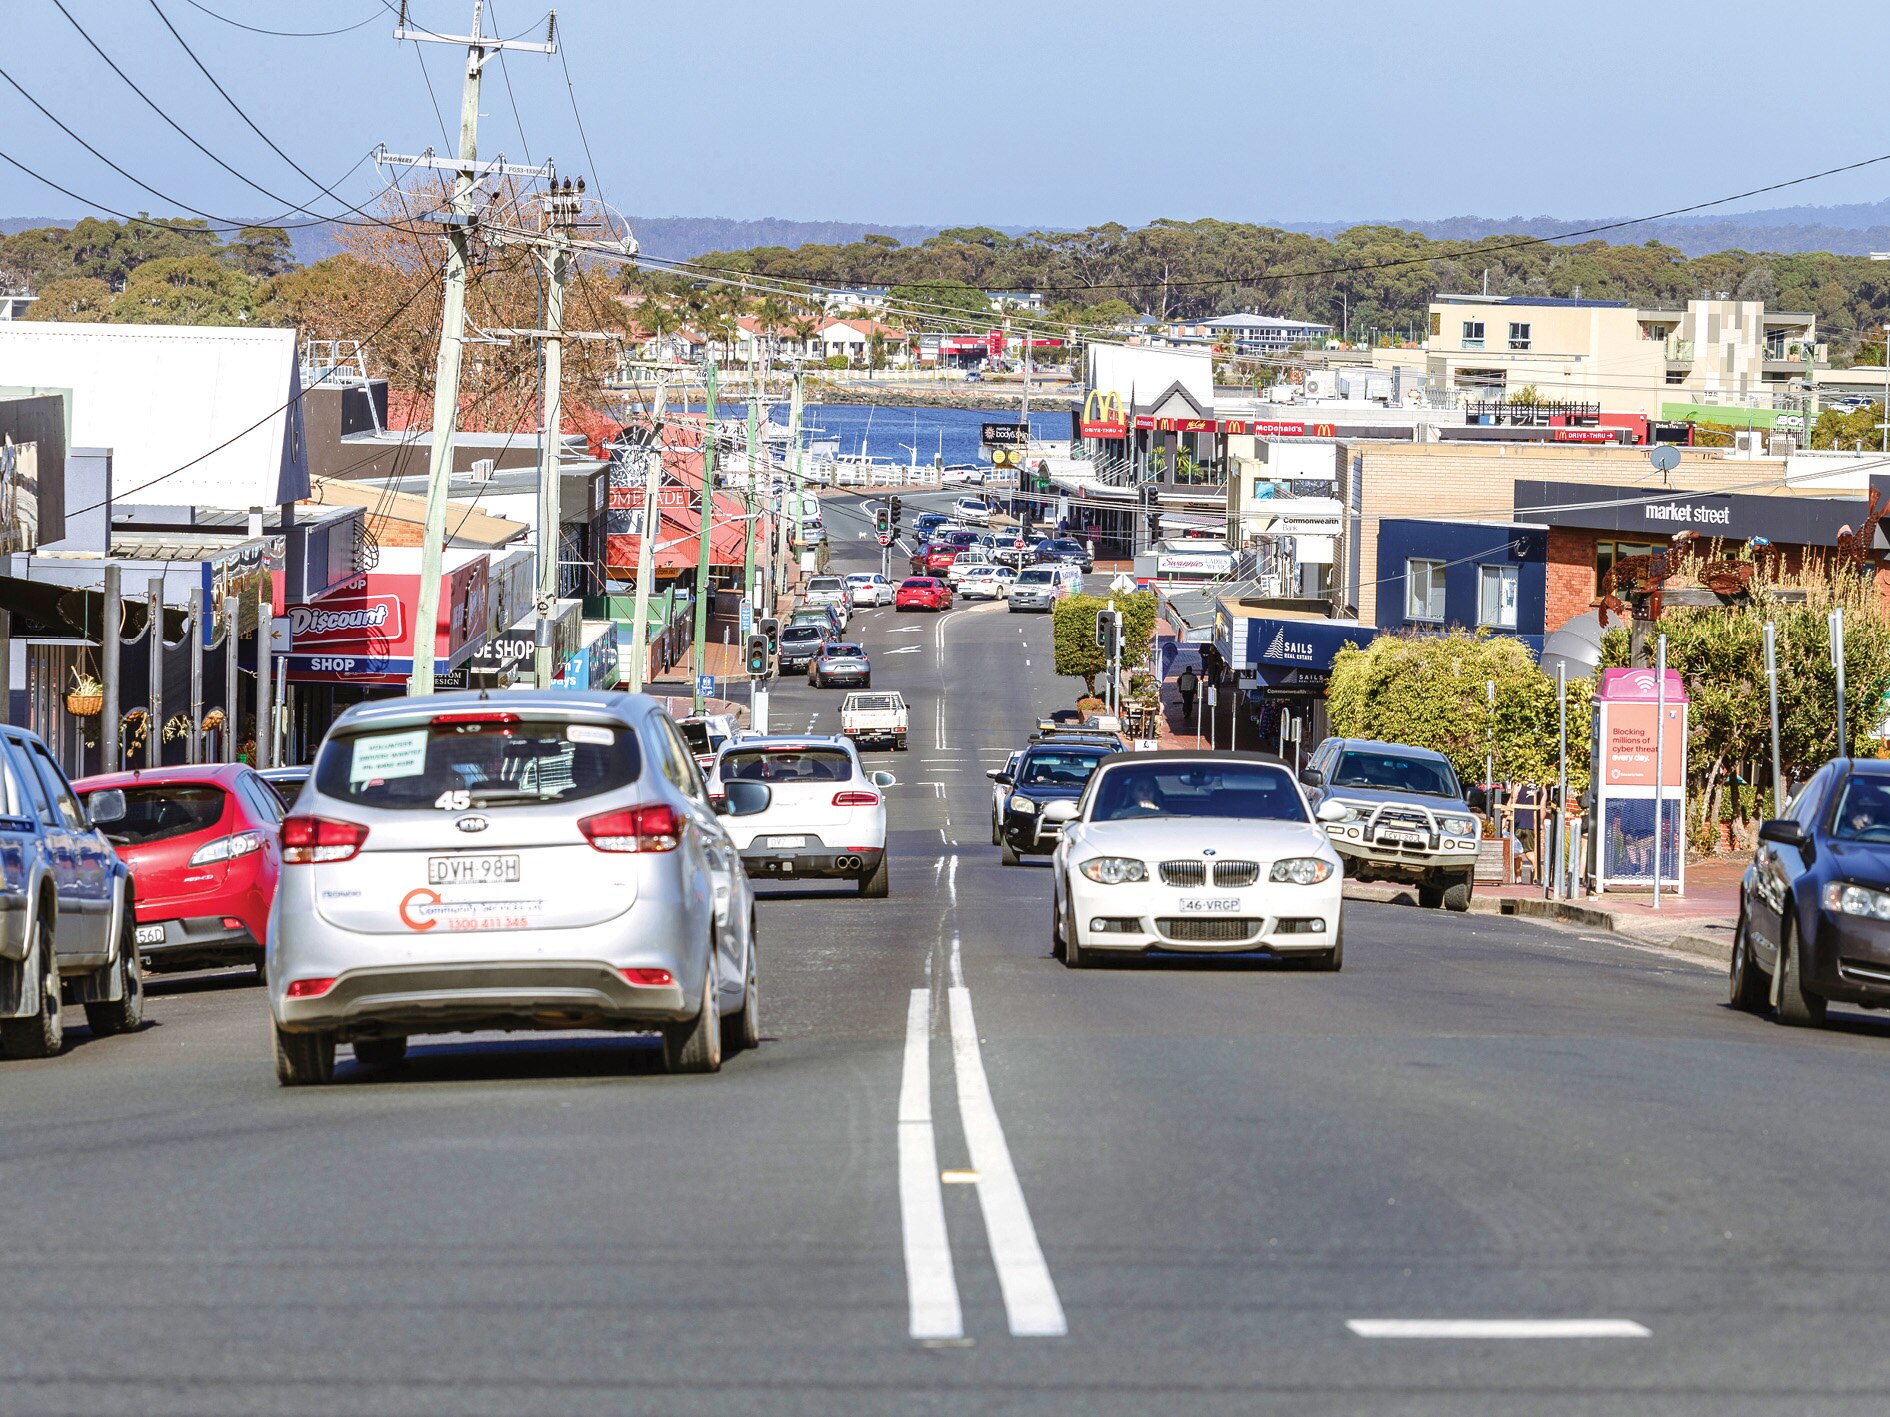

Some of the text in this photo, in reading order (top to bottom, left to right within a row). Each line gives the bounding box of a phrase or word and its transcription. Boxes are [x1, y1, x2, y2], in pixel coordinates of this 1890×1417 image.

[382, 155, 413, 164] WAGNERS
[1255, 424, 1302, 432] McDonald's
[1645, 502, 1730, 525] market street
[289, 607, 387, 632] Discount
[495, 640, 535, 660] SHOP
[1284, 642, 1313, 654] SAILS
[311, 658, 356, 671] SHOP
[1613, 728, 1645, 736] Blocking
[1612, 754, 1634, 762] every
[435, 790, 471, 811] 45
[449, 918, 478, 930] 1300
